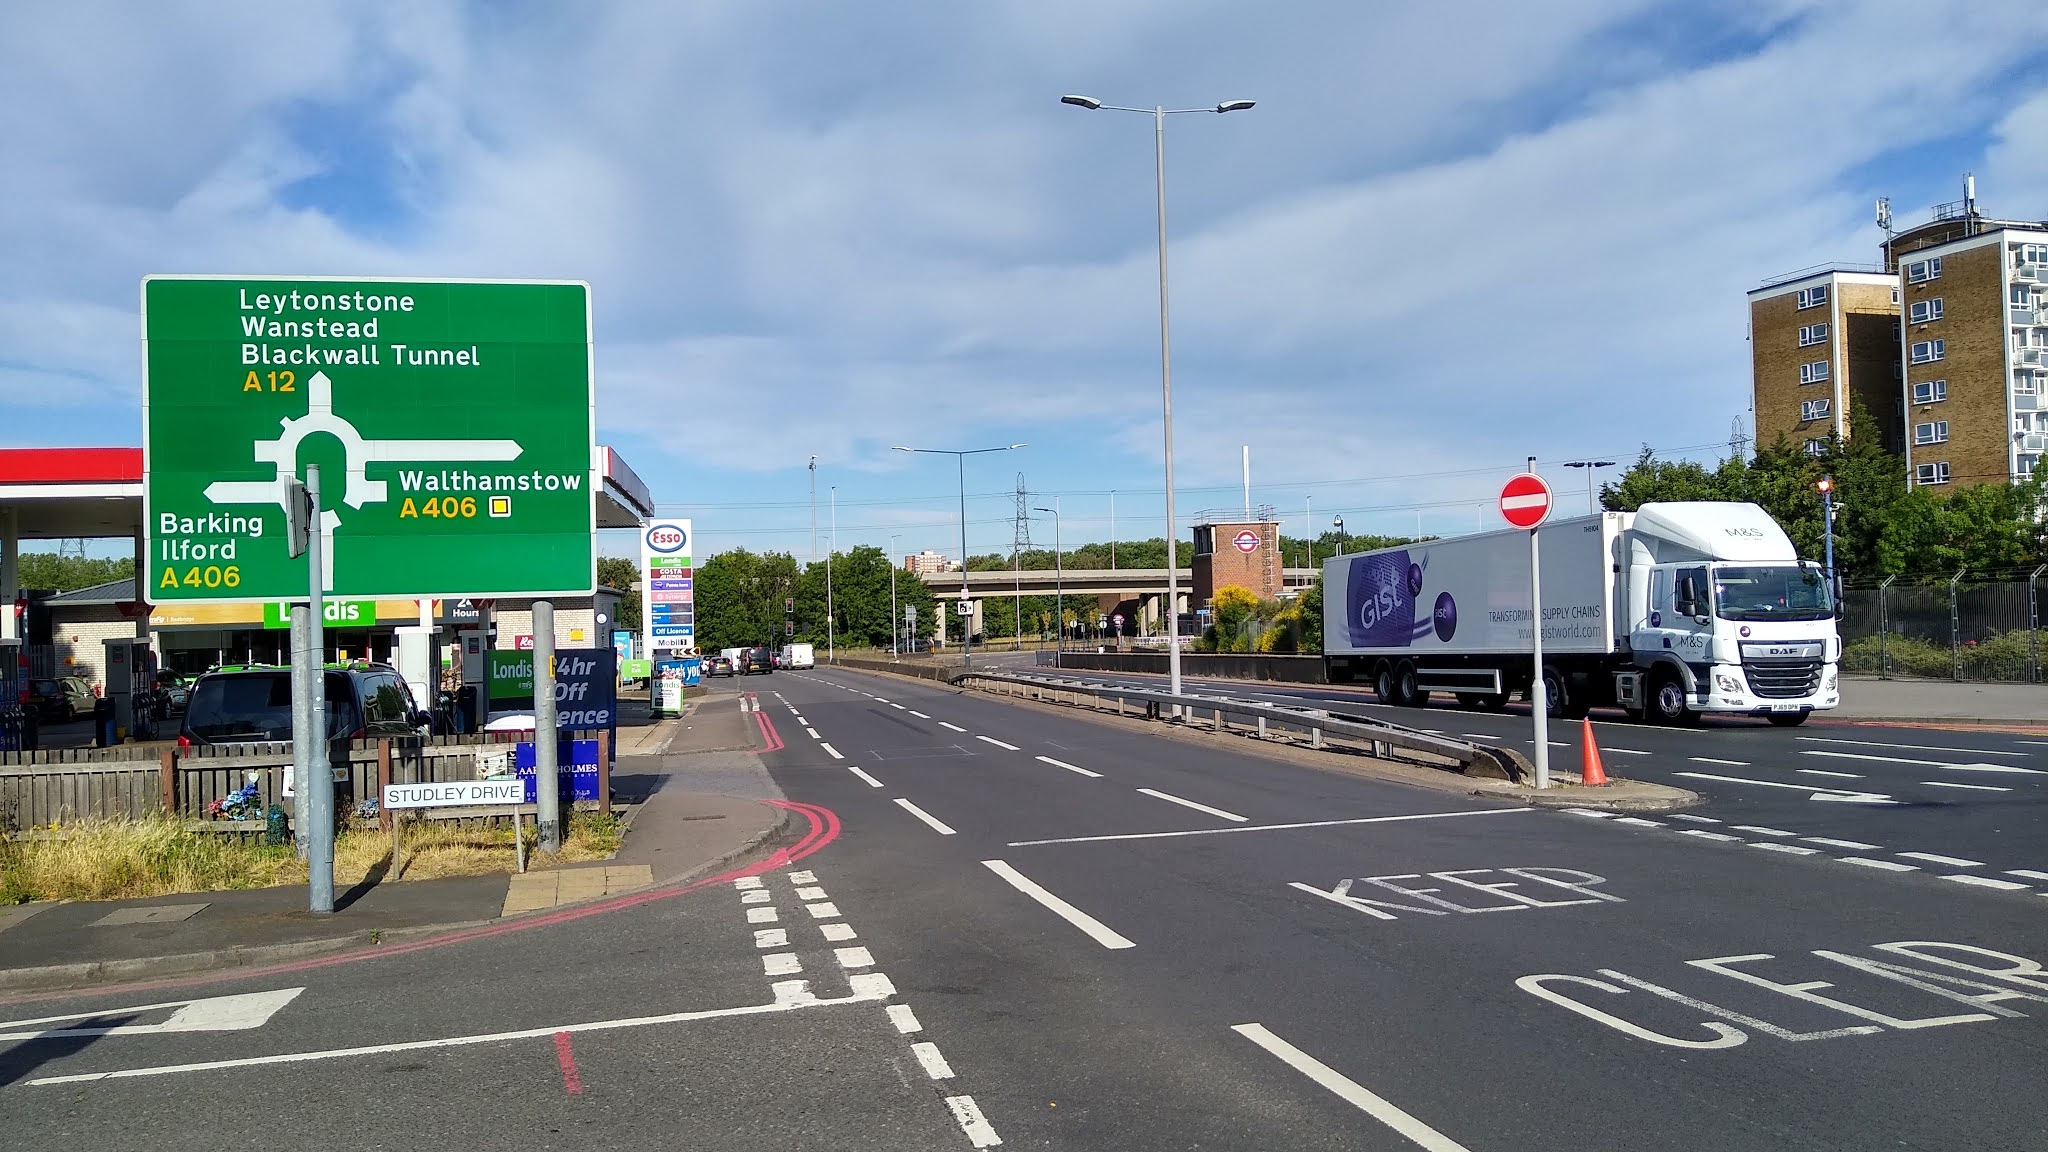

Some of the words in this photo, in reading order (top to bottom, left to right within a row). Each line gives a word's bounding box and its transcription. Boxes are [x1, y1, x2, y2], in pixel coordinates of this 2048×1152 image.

[240, 288, 415, 314] Leytonstone
[241, 316, 379, 338] Wanstead
[242, 343, 380, 365] Blackwall
[391, 344, 480, 366] Tunnel
[399, 470, 581, 491] Walthamstow
[160, 512, 264, 538] Barking
[1725, 528, 1764, 537] M&S
[653, 531, 681, 543] Esso
[161, 538, 237, 561] Ilford
[452, 609, 480, 617] Hours
[1488, 609, 1534, 622] TRANSFORMIN
[1542, 606, 1570, 620] SUPPLY
[1571, 605, 1601, 619] CHAINS
[1680, 636, 1703, 648] M&S
[493, 659, 533, 679] Londis
[654, 681, 680, 689] Londis
[388, 787, 466, 803] STUDLEY
[471, 786, 520, 799] DRIVE
[1287, 867, 1626, 919] KEEP
[1515, 941, 2048, 1049] CLEAR
